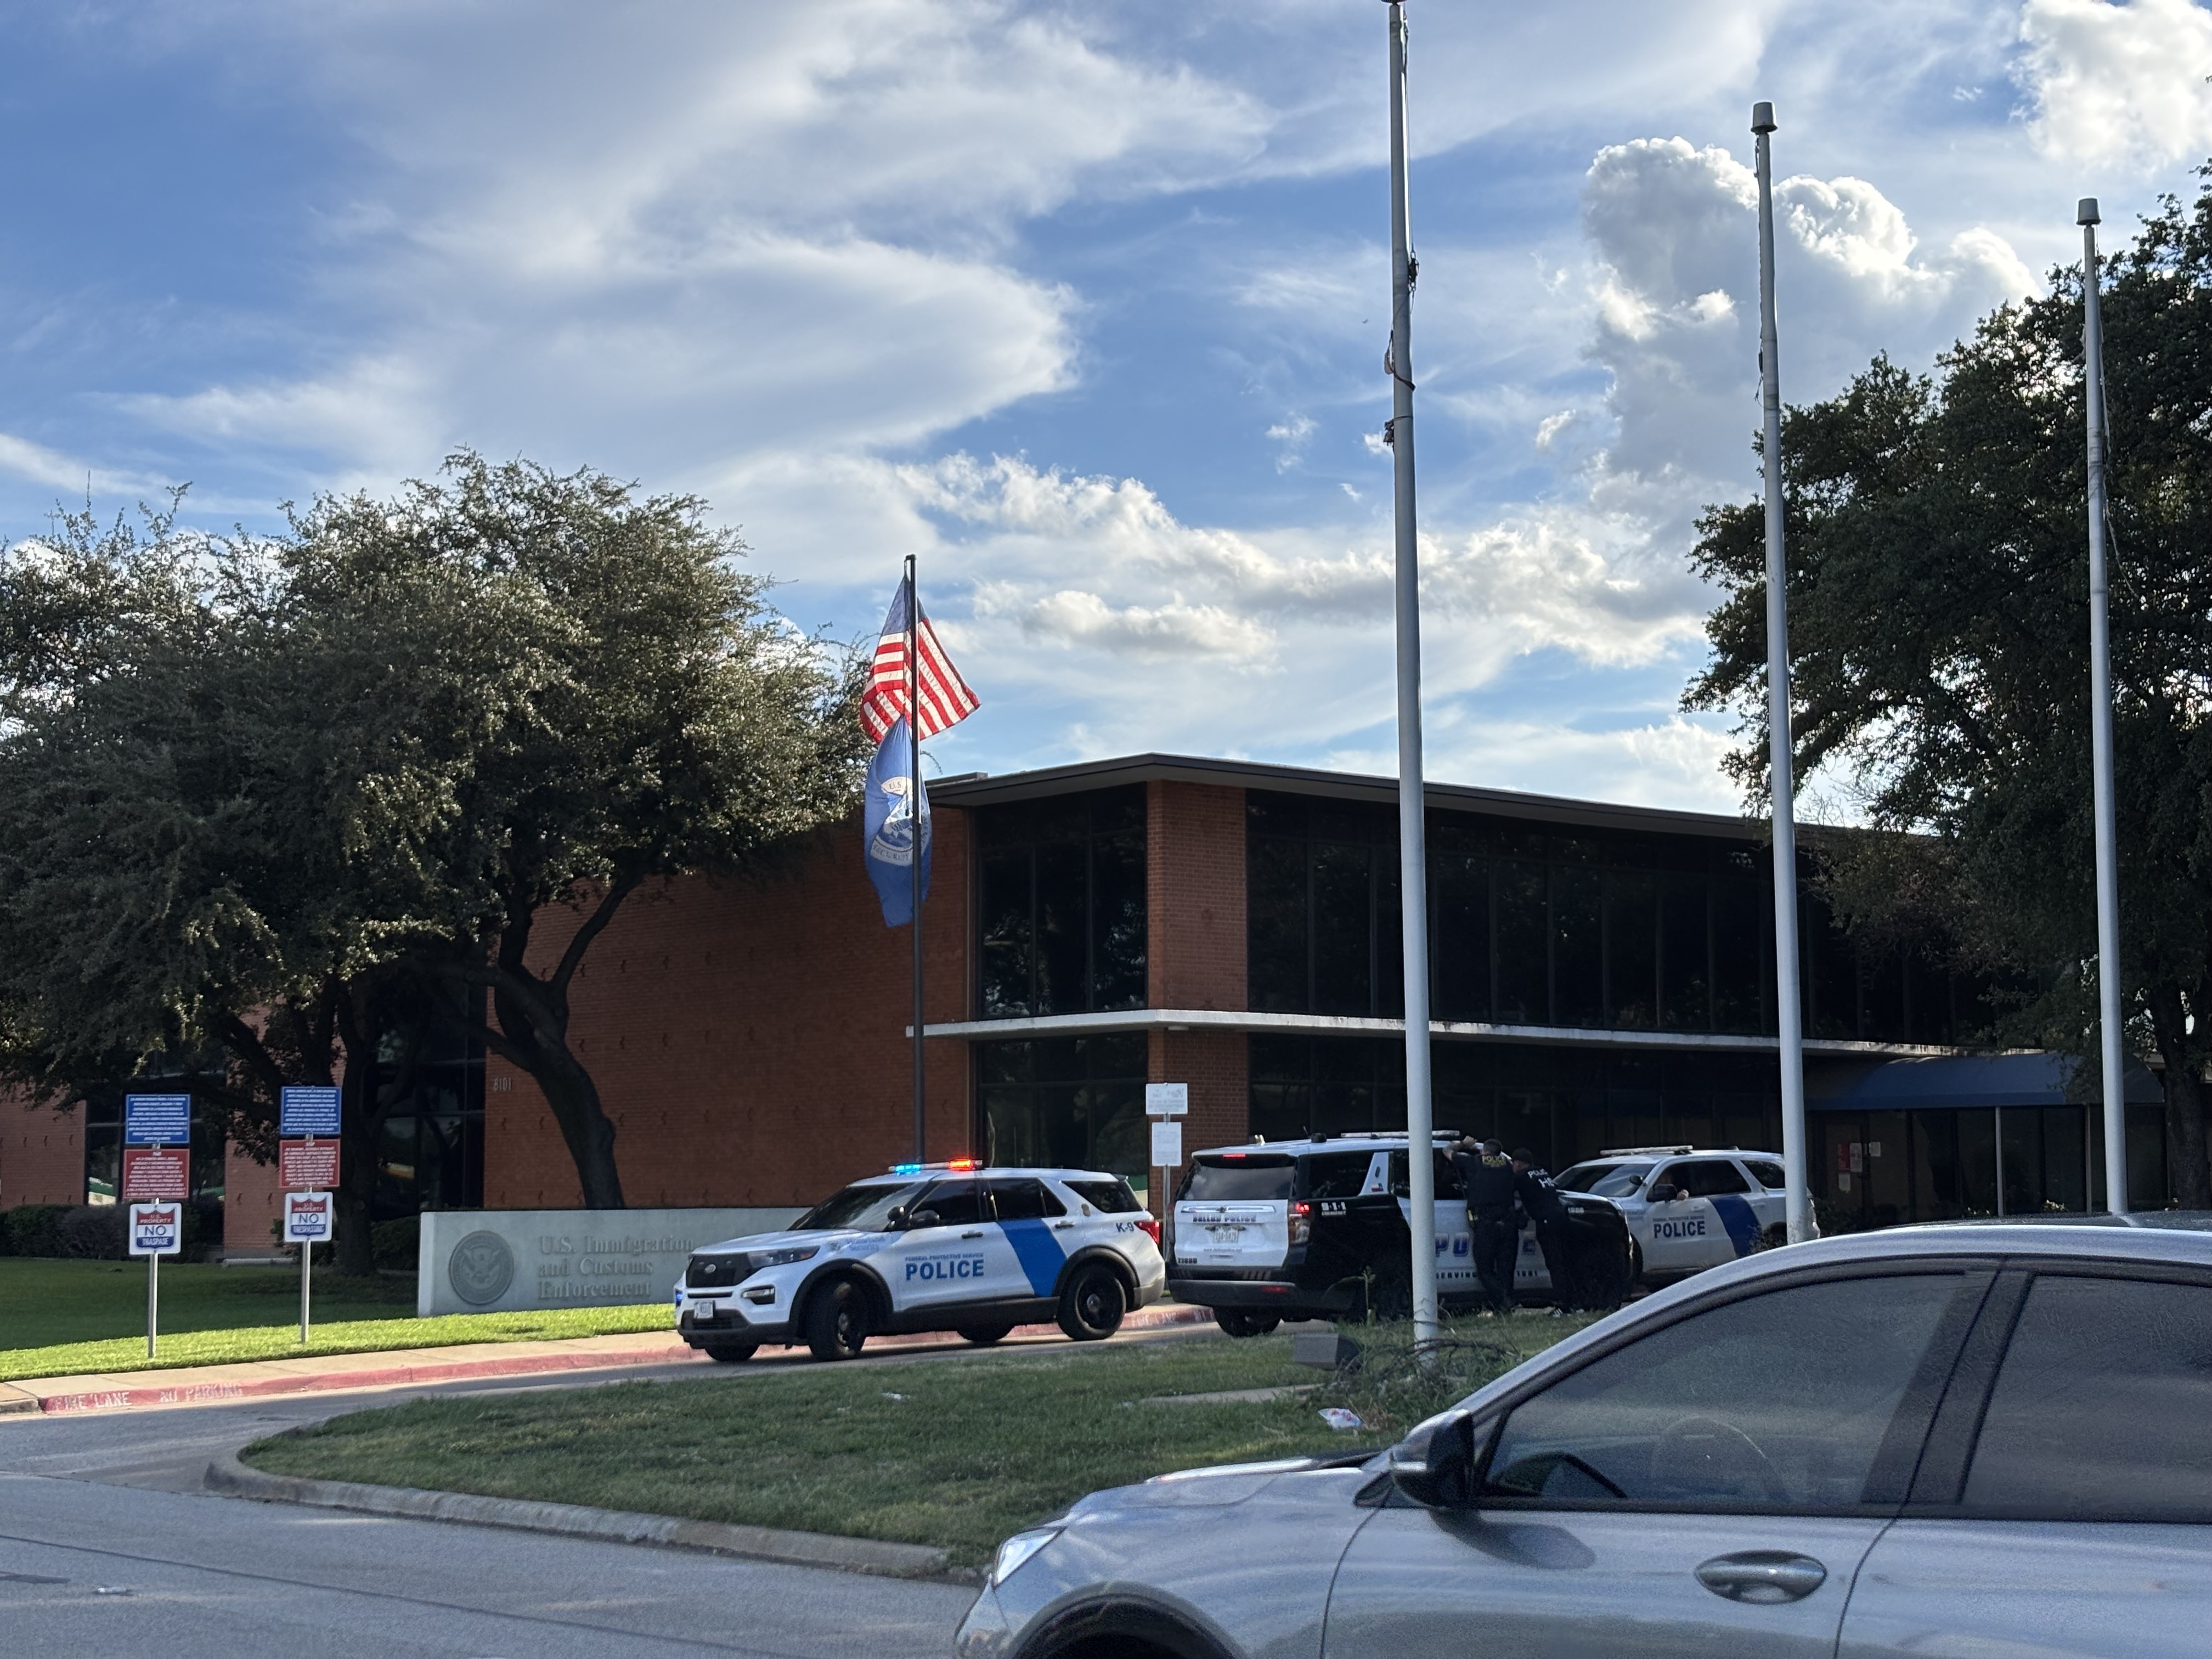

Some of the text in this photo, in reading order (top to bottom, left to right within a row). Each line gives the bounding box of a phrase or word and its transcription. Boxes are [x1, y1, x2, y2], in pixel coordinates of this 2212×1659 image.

[889, 781, 903, 789] U.S.
[299, 1214, 319, 1223] NO
[1116, 1222, 1135, 1232] K-9
[145, 1226, 166, 1236] NO
[293, 1225, 324, 1233] TRESPASSING
[1654, 1221, 1706, 1238] POLICE
[540, 1234, 694, 1255] U.S. Immigration
[539, 1257, 654, 1277] and Customs
[906, 1259, 984, 1281] POLICE
[538, 1280, 651, 1300] Enforcement
[55, 1383, 242, 1411] FIRE LANE NO PARKING
